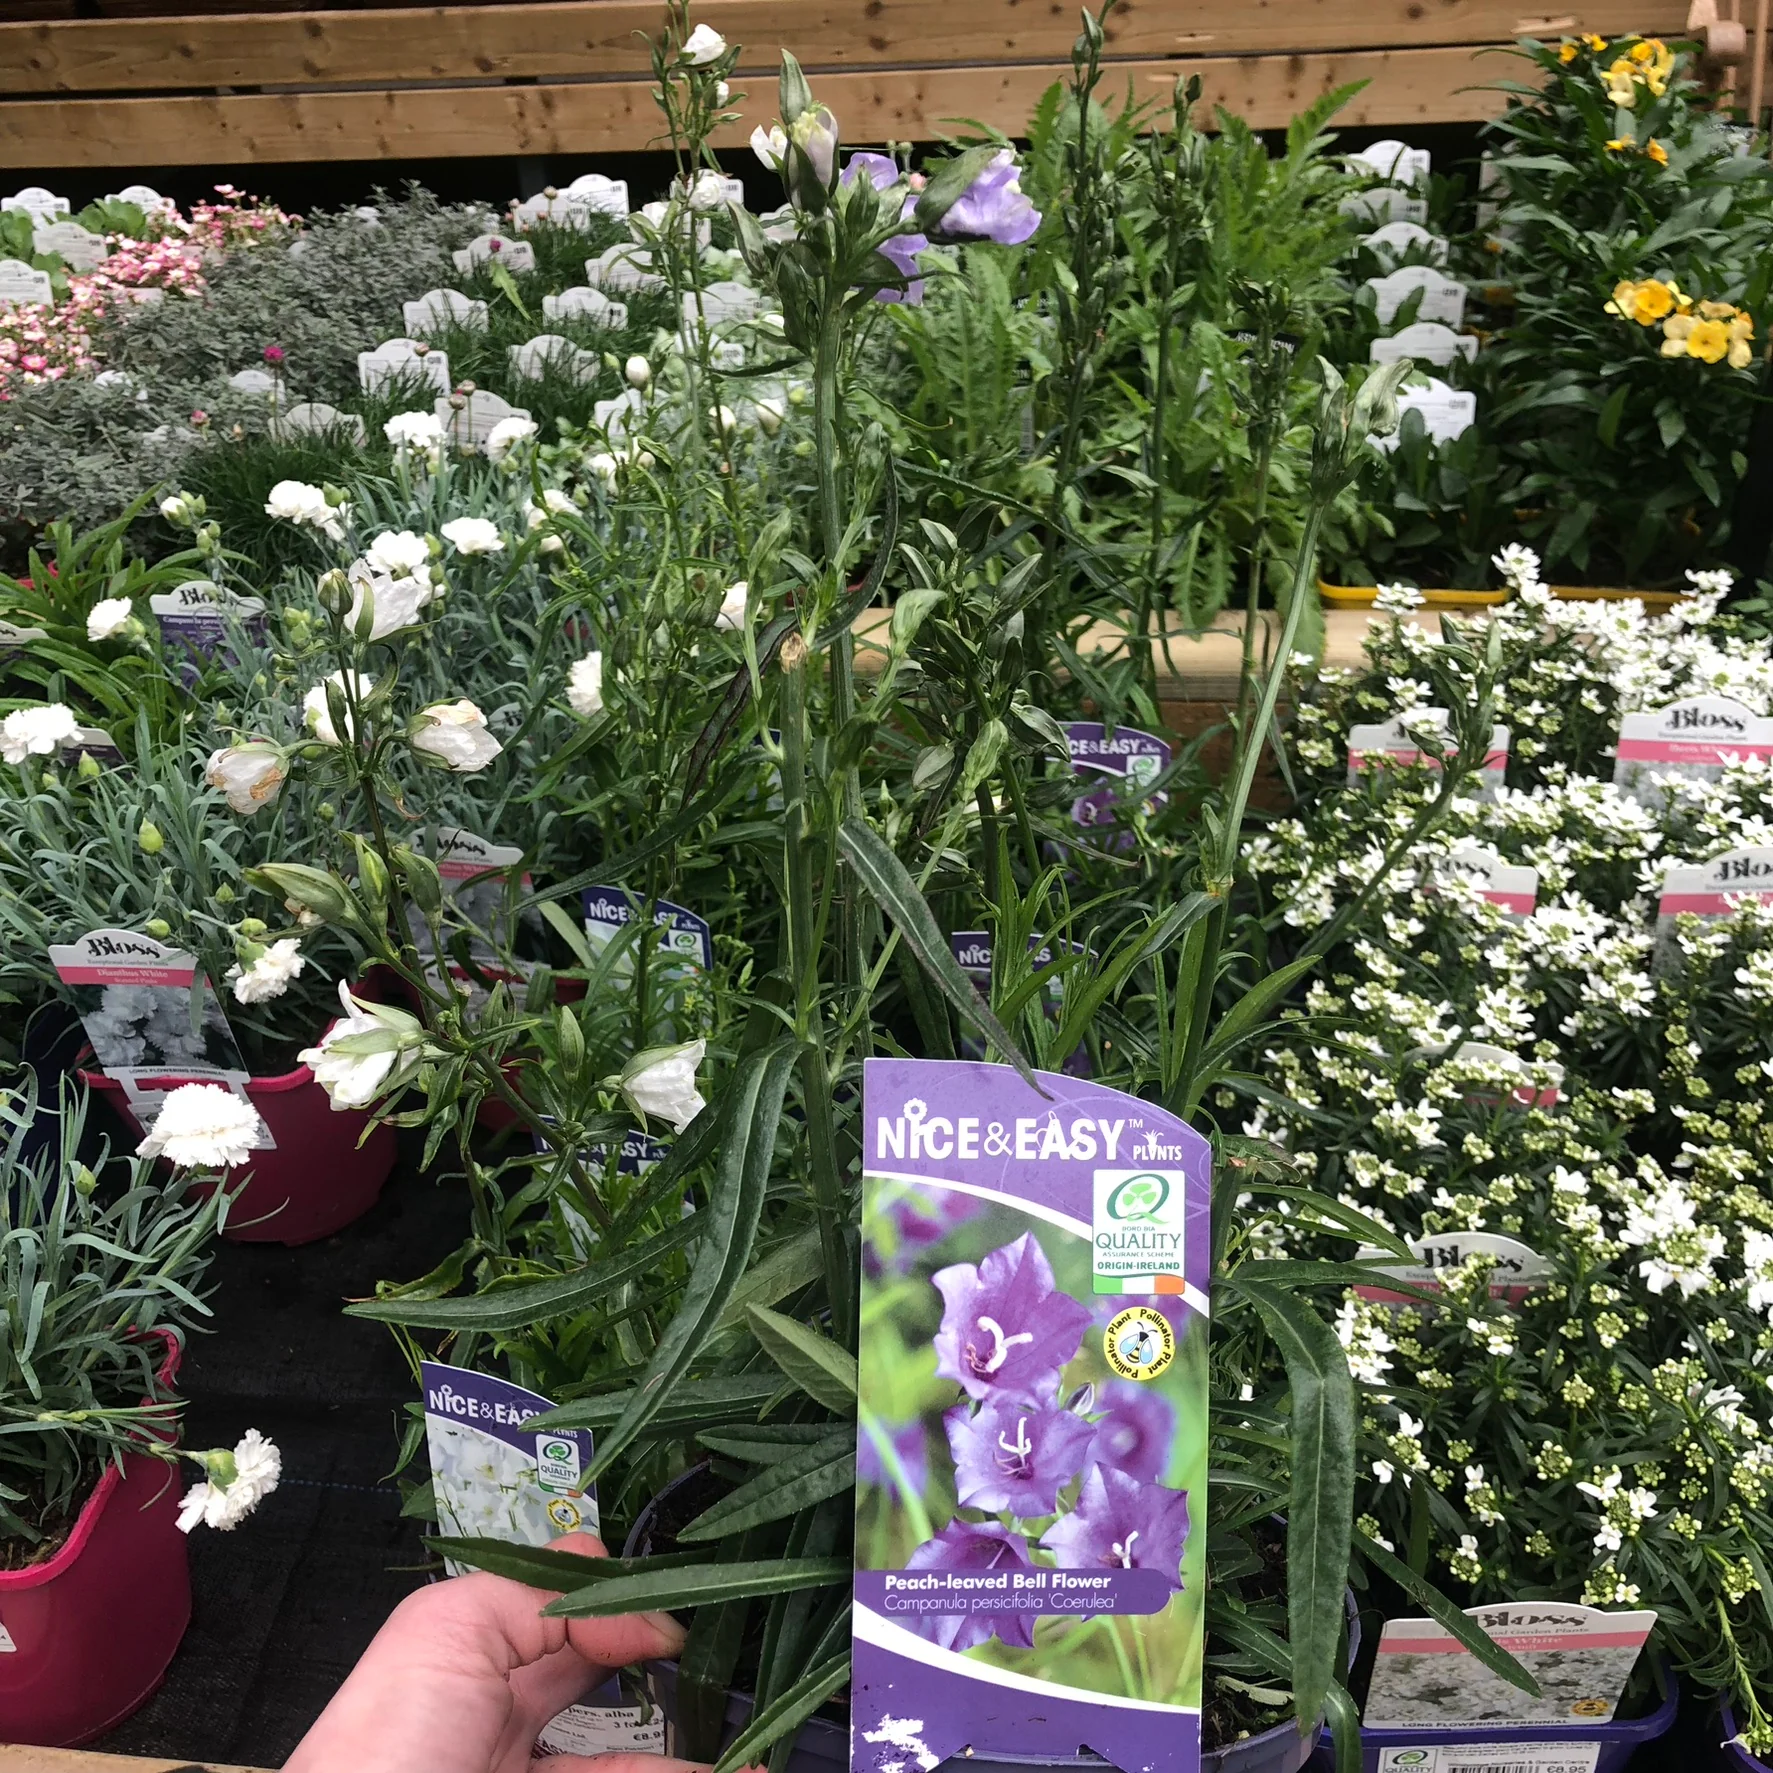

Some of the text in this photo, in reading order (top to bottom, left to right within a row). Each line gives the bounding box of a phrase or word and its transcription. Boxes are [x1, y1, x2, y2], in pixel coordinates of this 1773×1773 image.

[1665, 707, 1746, 732] Bloss
[1066, 739, 1140, 755] CE&EASY
[86, 937, 160, 958] Bloss
[97, 968, 169, 978] Dianthus White
[190, 1069, 227, 1077] PERENNIAL
[1133, 1136, 1182, 1161] PLANTS
[1096, 1232, 1181, 1250] QUALITY
[1097, 1261, 1180, 1270] ORIGIN-IRELAND
[1107, 1312, 1139, 1379] Pollinator Plant
[1139, 1308, 1172, 1375] Pollinator Plant
[429, 1384, 542, 1426] NICE&EAS
[541, 1464, 578, 1479] QUALITY
[885, 1573, 1111, 1590] Peach-leaved Bell Flower
[884, 1592, 1118, 1614] Campanula persicifolia 'Coerulea'
[1514, 1637, 1563, 1645] White
[604, 1710, 634, 1719] alba
[613, 1721, 620, 1729] 3
[1436, 1720, 1503, 1728] FLOWERING
